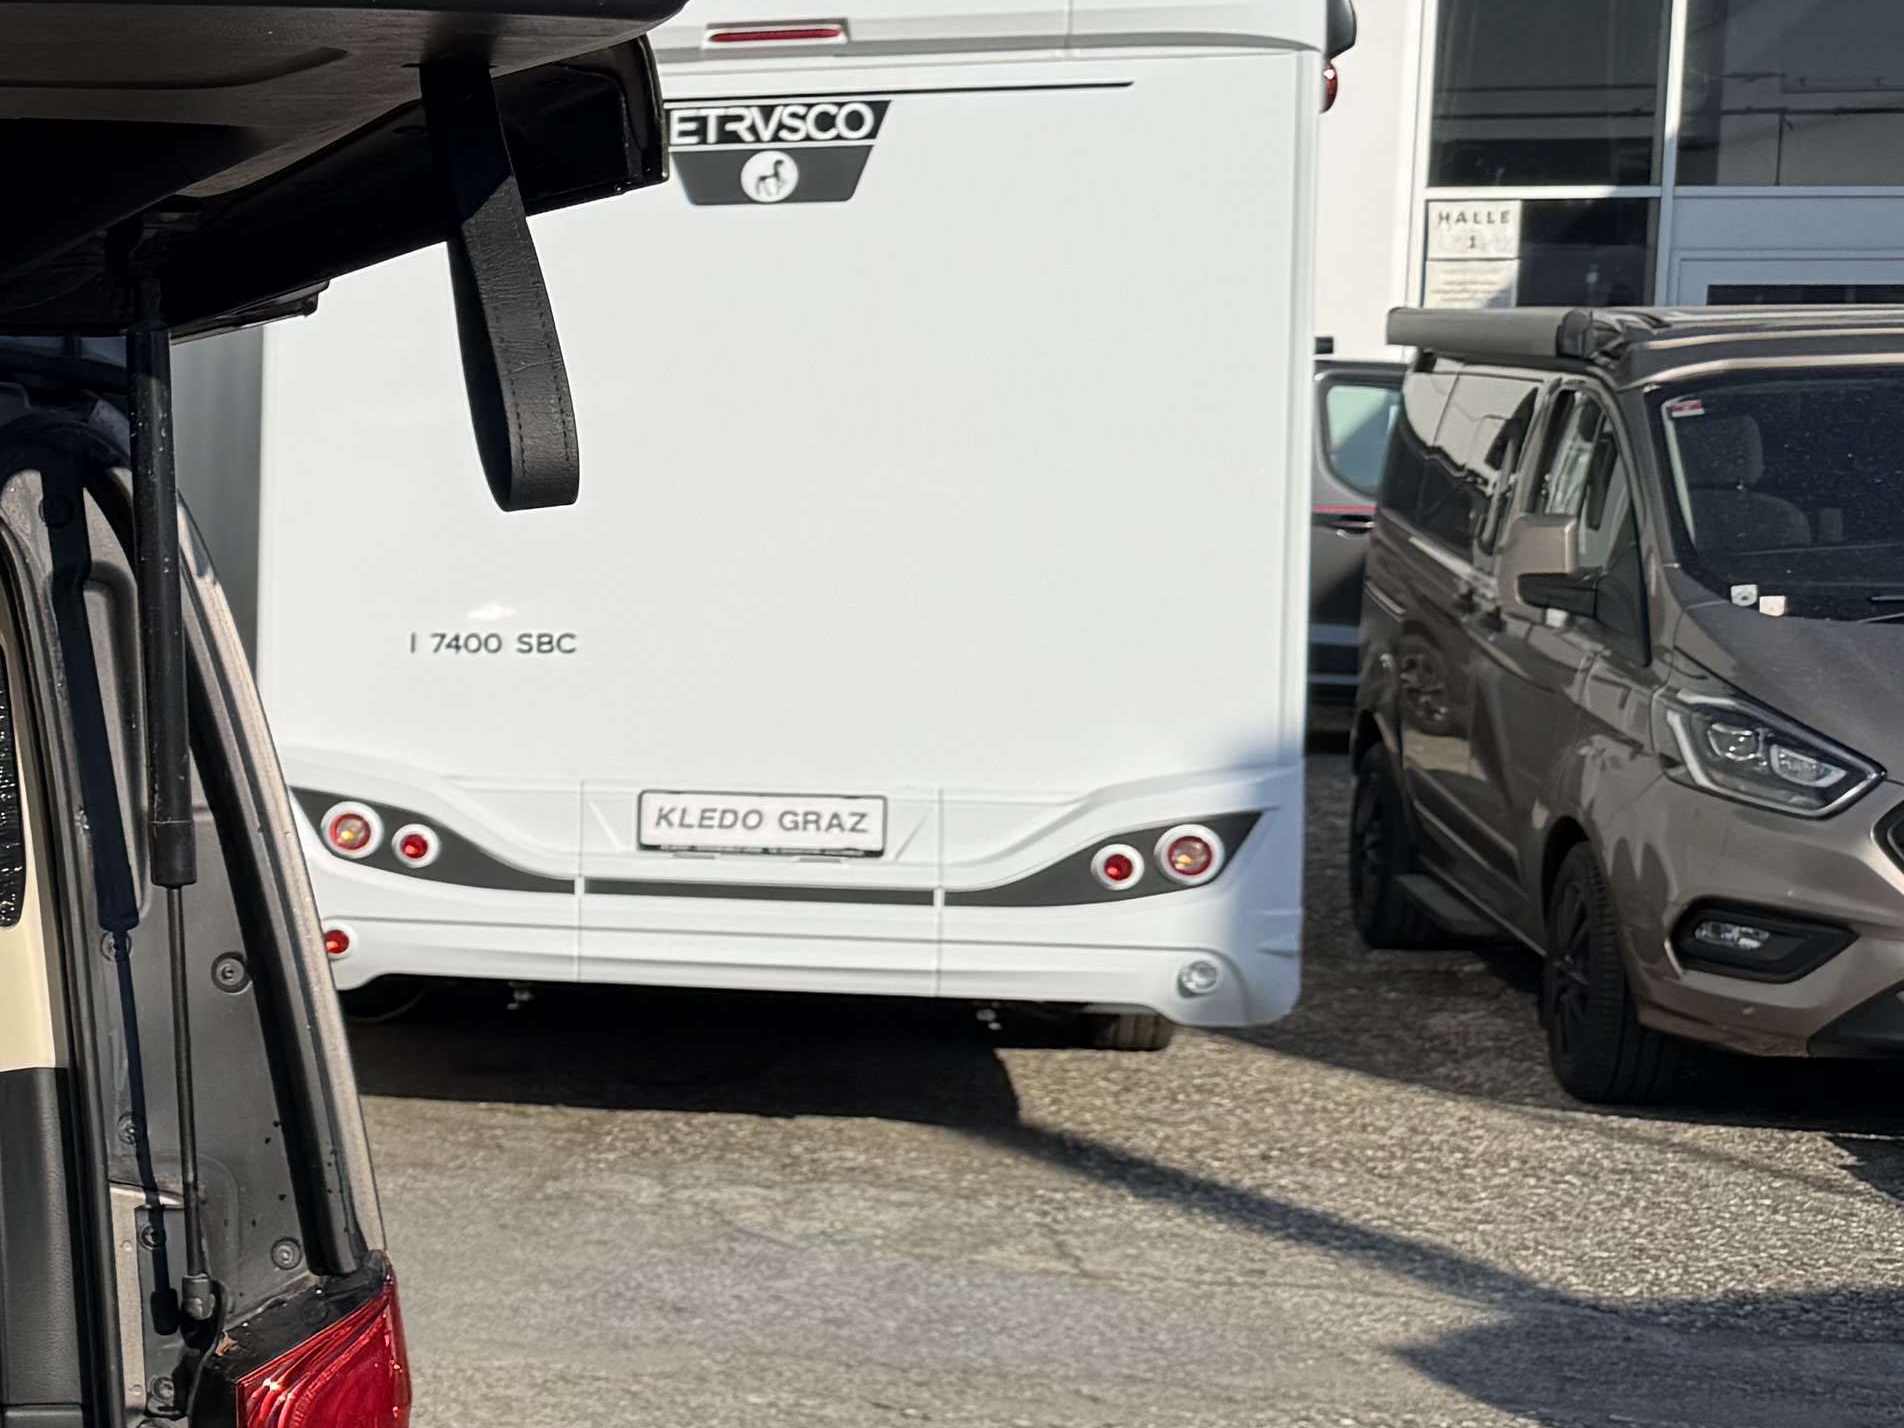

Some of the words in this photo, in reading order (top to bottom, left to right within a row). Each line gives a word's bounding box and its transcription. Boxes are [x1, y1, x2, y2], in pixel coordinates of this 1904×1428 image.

[1438, 210, 1510, 225] HALLE
[430, 632, 503, 655] 7400
[516, 632, 577, 655] SBC
[655, 807, 764, 831] KLEDO
[779, 810, 869, 834] GRAZ
